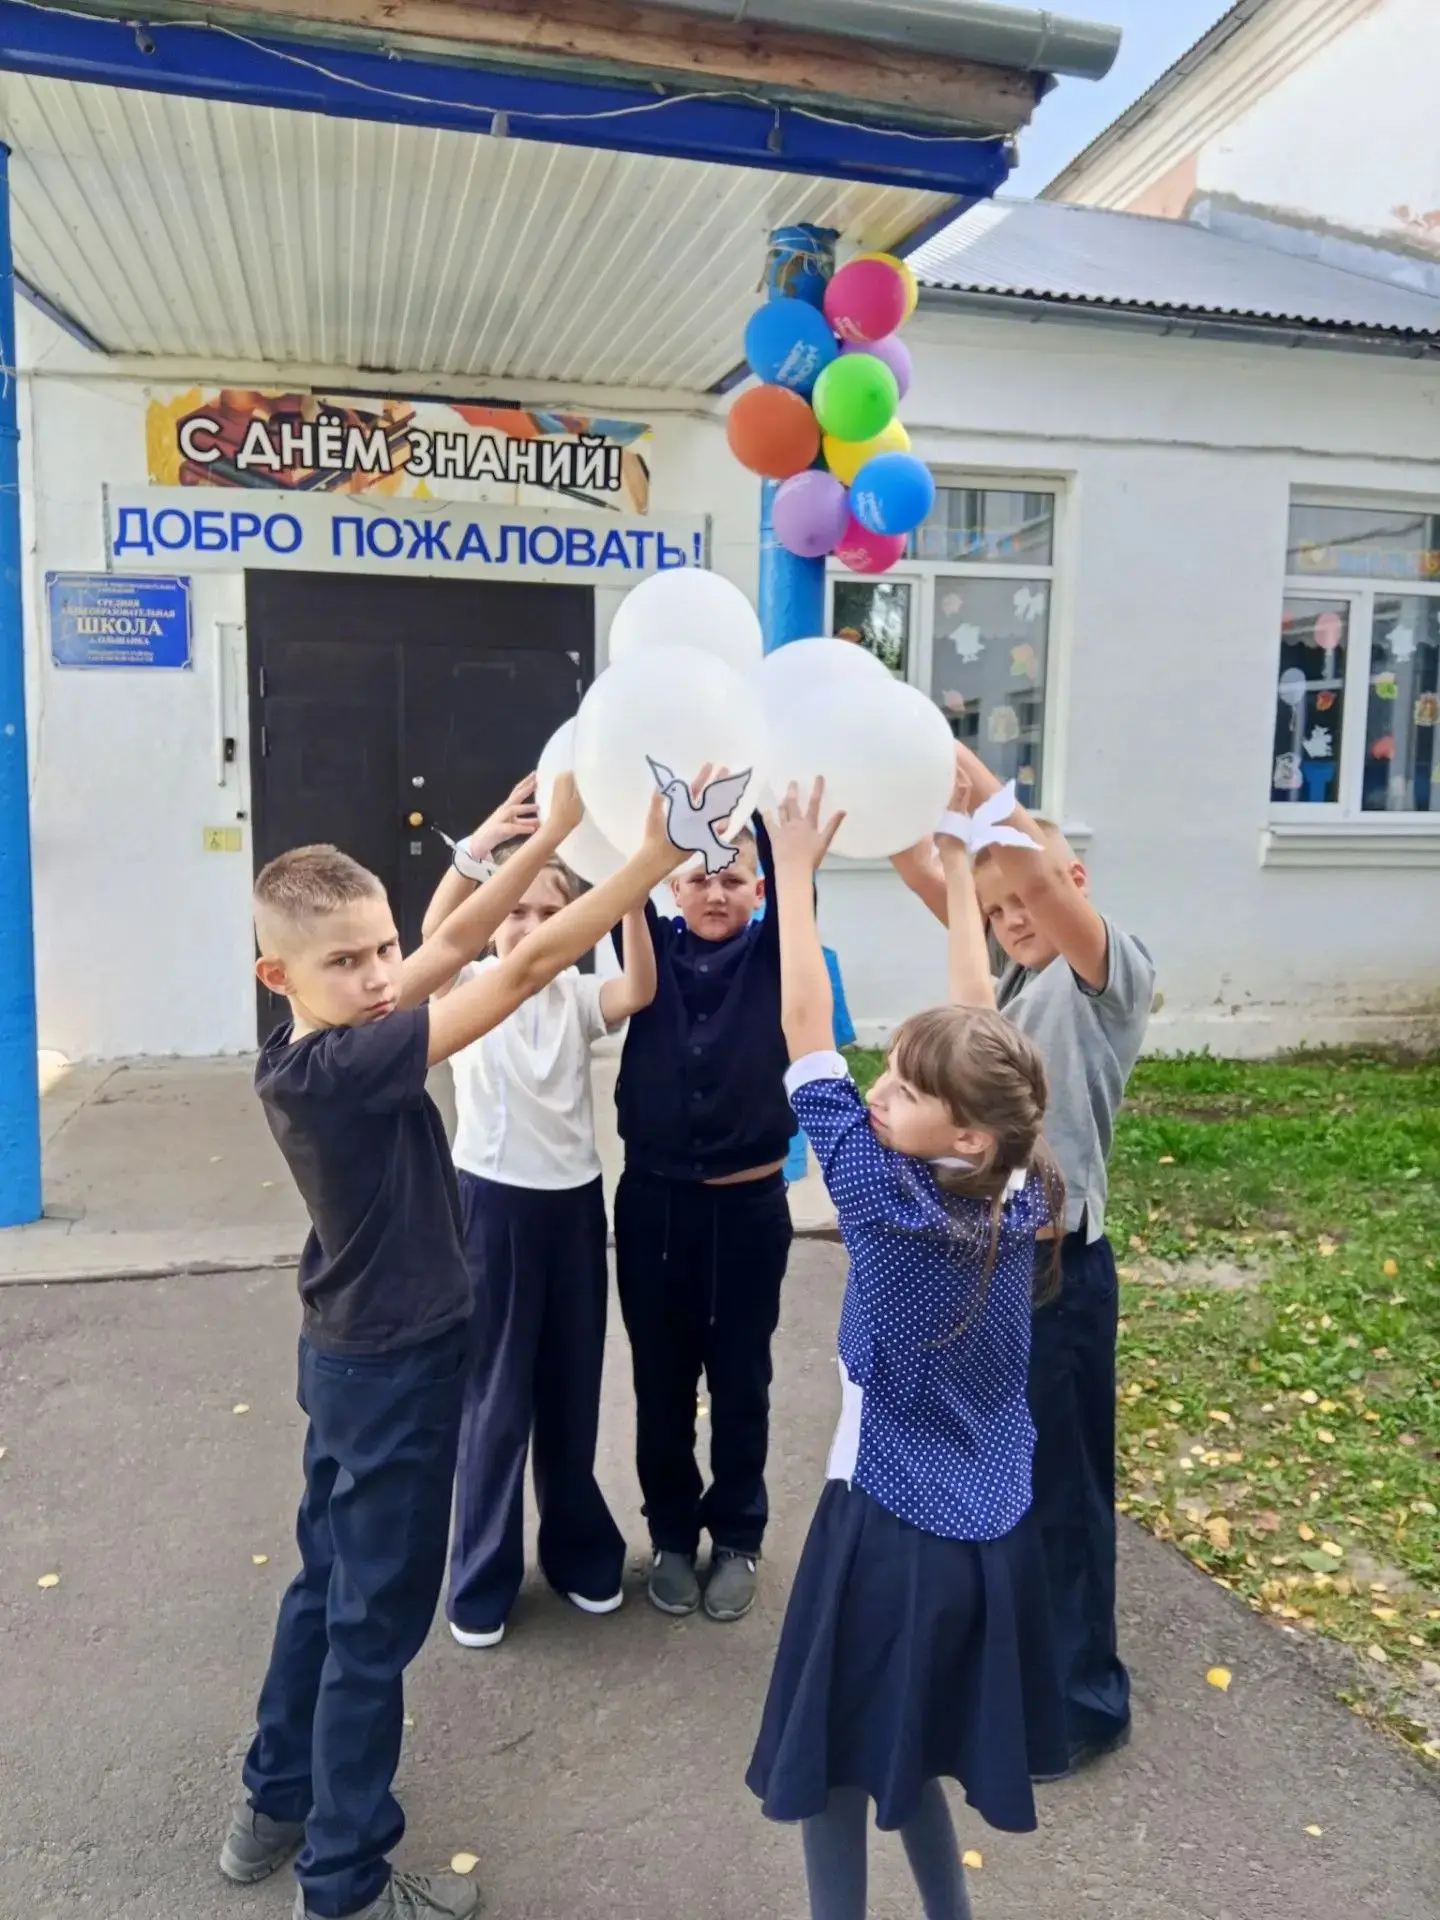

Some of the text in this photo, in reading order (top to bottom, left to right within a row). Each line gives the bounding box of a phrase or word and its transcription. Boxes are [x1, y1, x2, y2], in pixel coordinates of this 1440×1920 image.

[177, 411, 624, 492] С ДНЁМ ЗНАНИЙ!
[113, 507, 702, 570] ДОБРО ПОЖАЛОВАТЬ!
[77, 617, 163, 636] ШКОЛА
